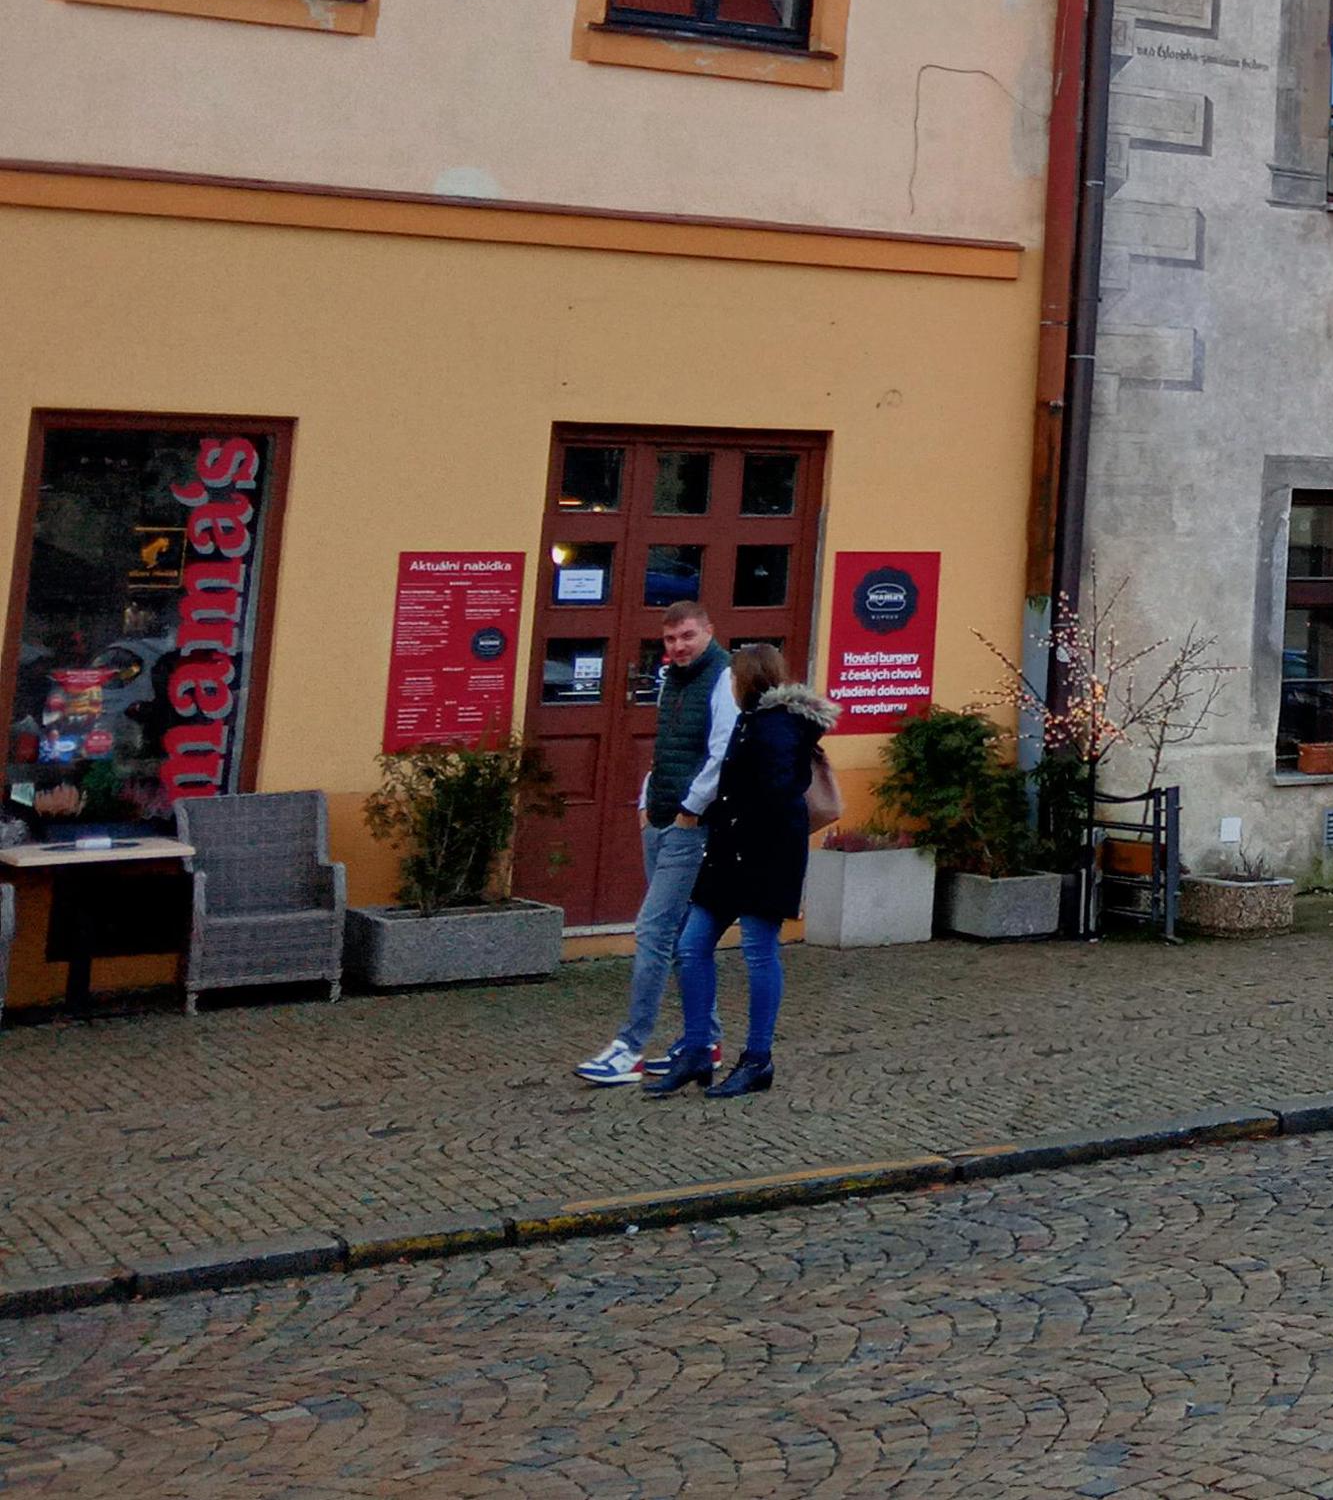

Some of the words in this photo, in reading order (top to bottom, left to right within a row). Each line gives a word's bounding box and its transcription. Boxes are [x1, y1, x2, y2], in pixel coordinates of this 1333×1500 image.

[409, 560, 460, 571] Aktuální
[463, 560, 512, 571] nabídka
[843, 652, 879, 665] Hovězí
[880, 652, 918, 665] burgery
[840, 672, 846, 680] z
[847, 667, 890, 682] českých
[891, 666, 922, 680] chovů
[830, 684, 876, 700] vyladěné
[877, 684, 930, 696] dokonalou
